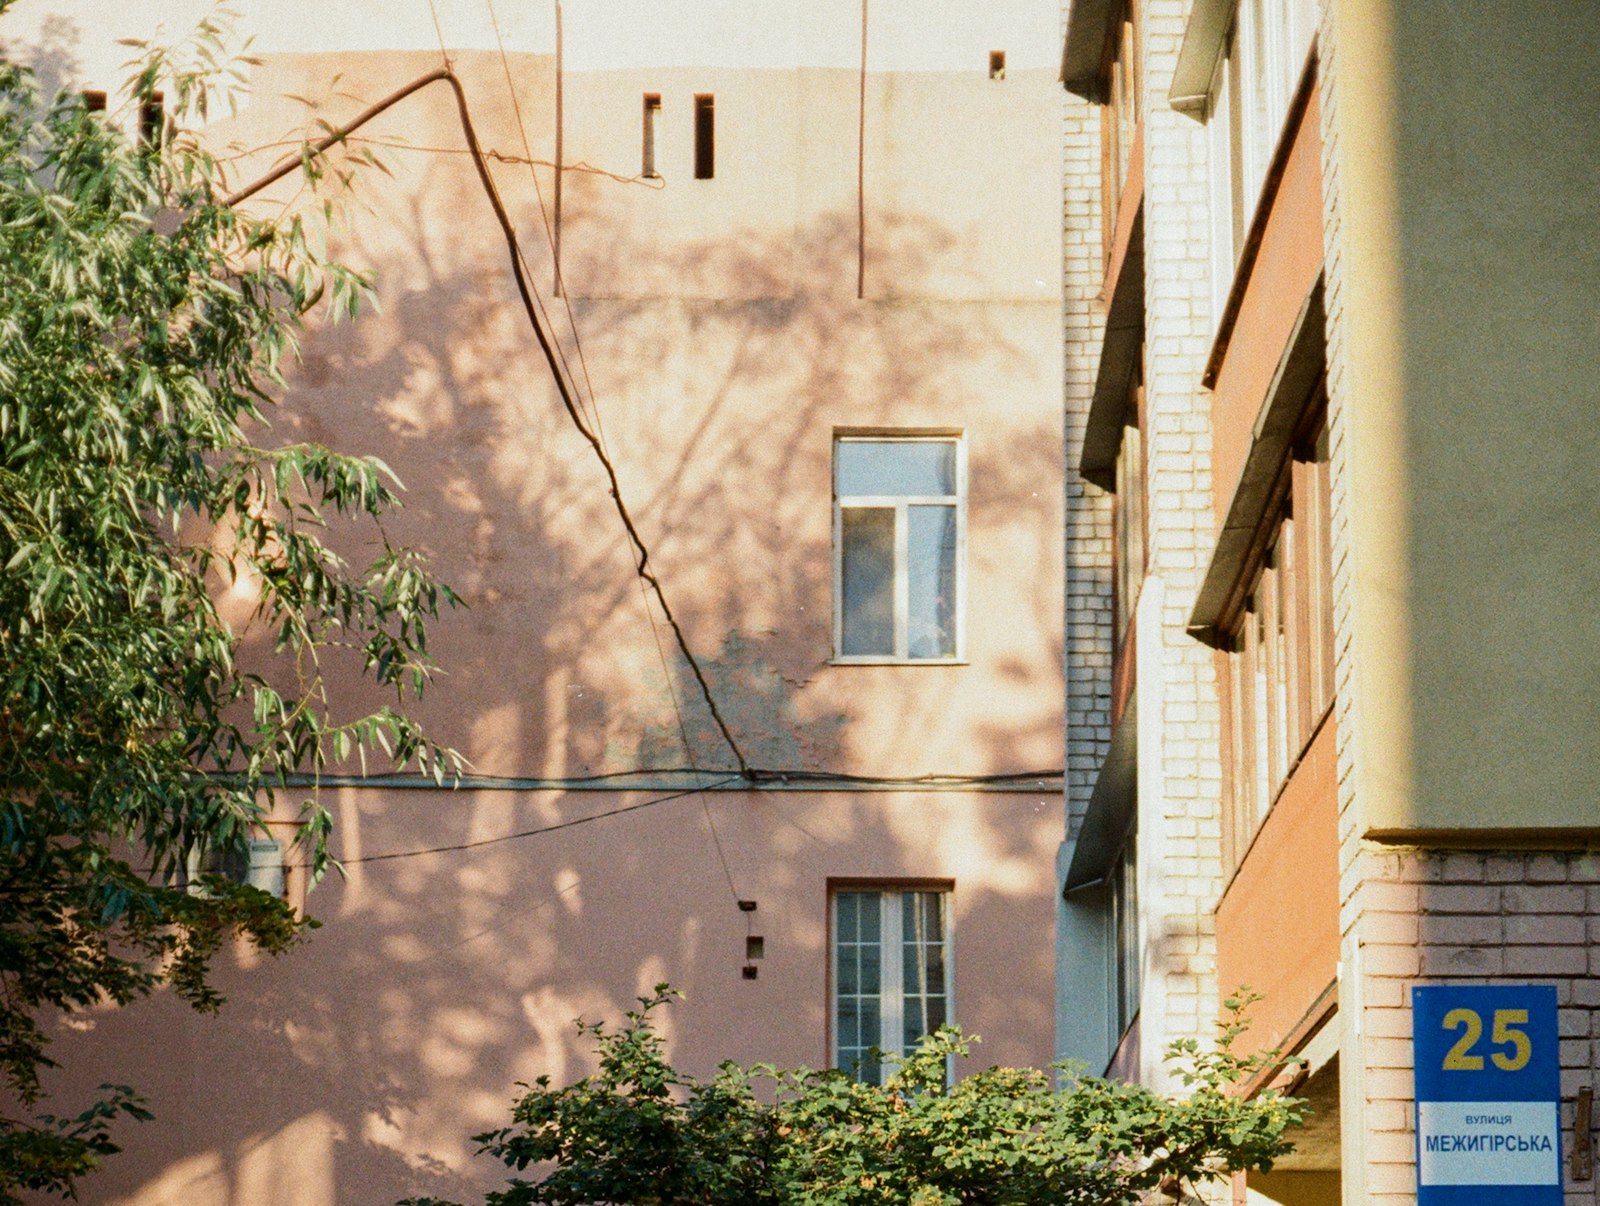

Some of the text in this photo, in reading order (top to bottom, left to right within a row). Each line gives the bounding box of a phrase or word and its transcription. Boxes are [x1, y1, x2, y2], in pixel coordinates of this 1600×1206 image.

[1441, 1008, 1532, 1071] 25
[1465, 1115, 1512, 1125] ВУЛИЦЯ
[1425, 1134, 1552, 1151] МЕЖИГІРСЬКА
